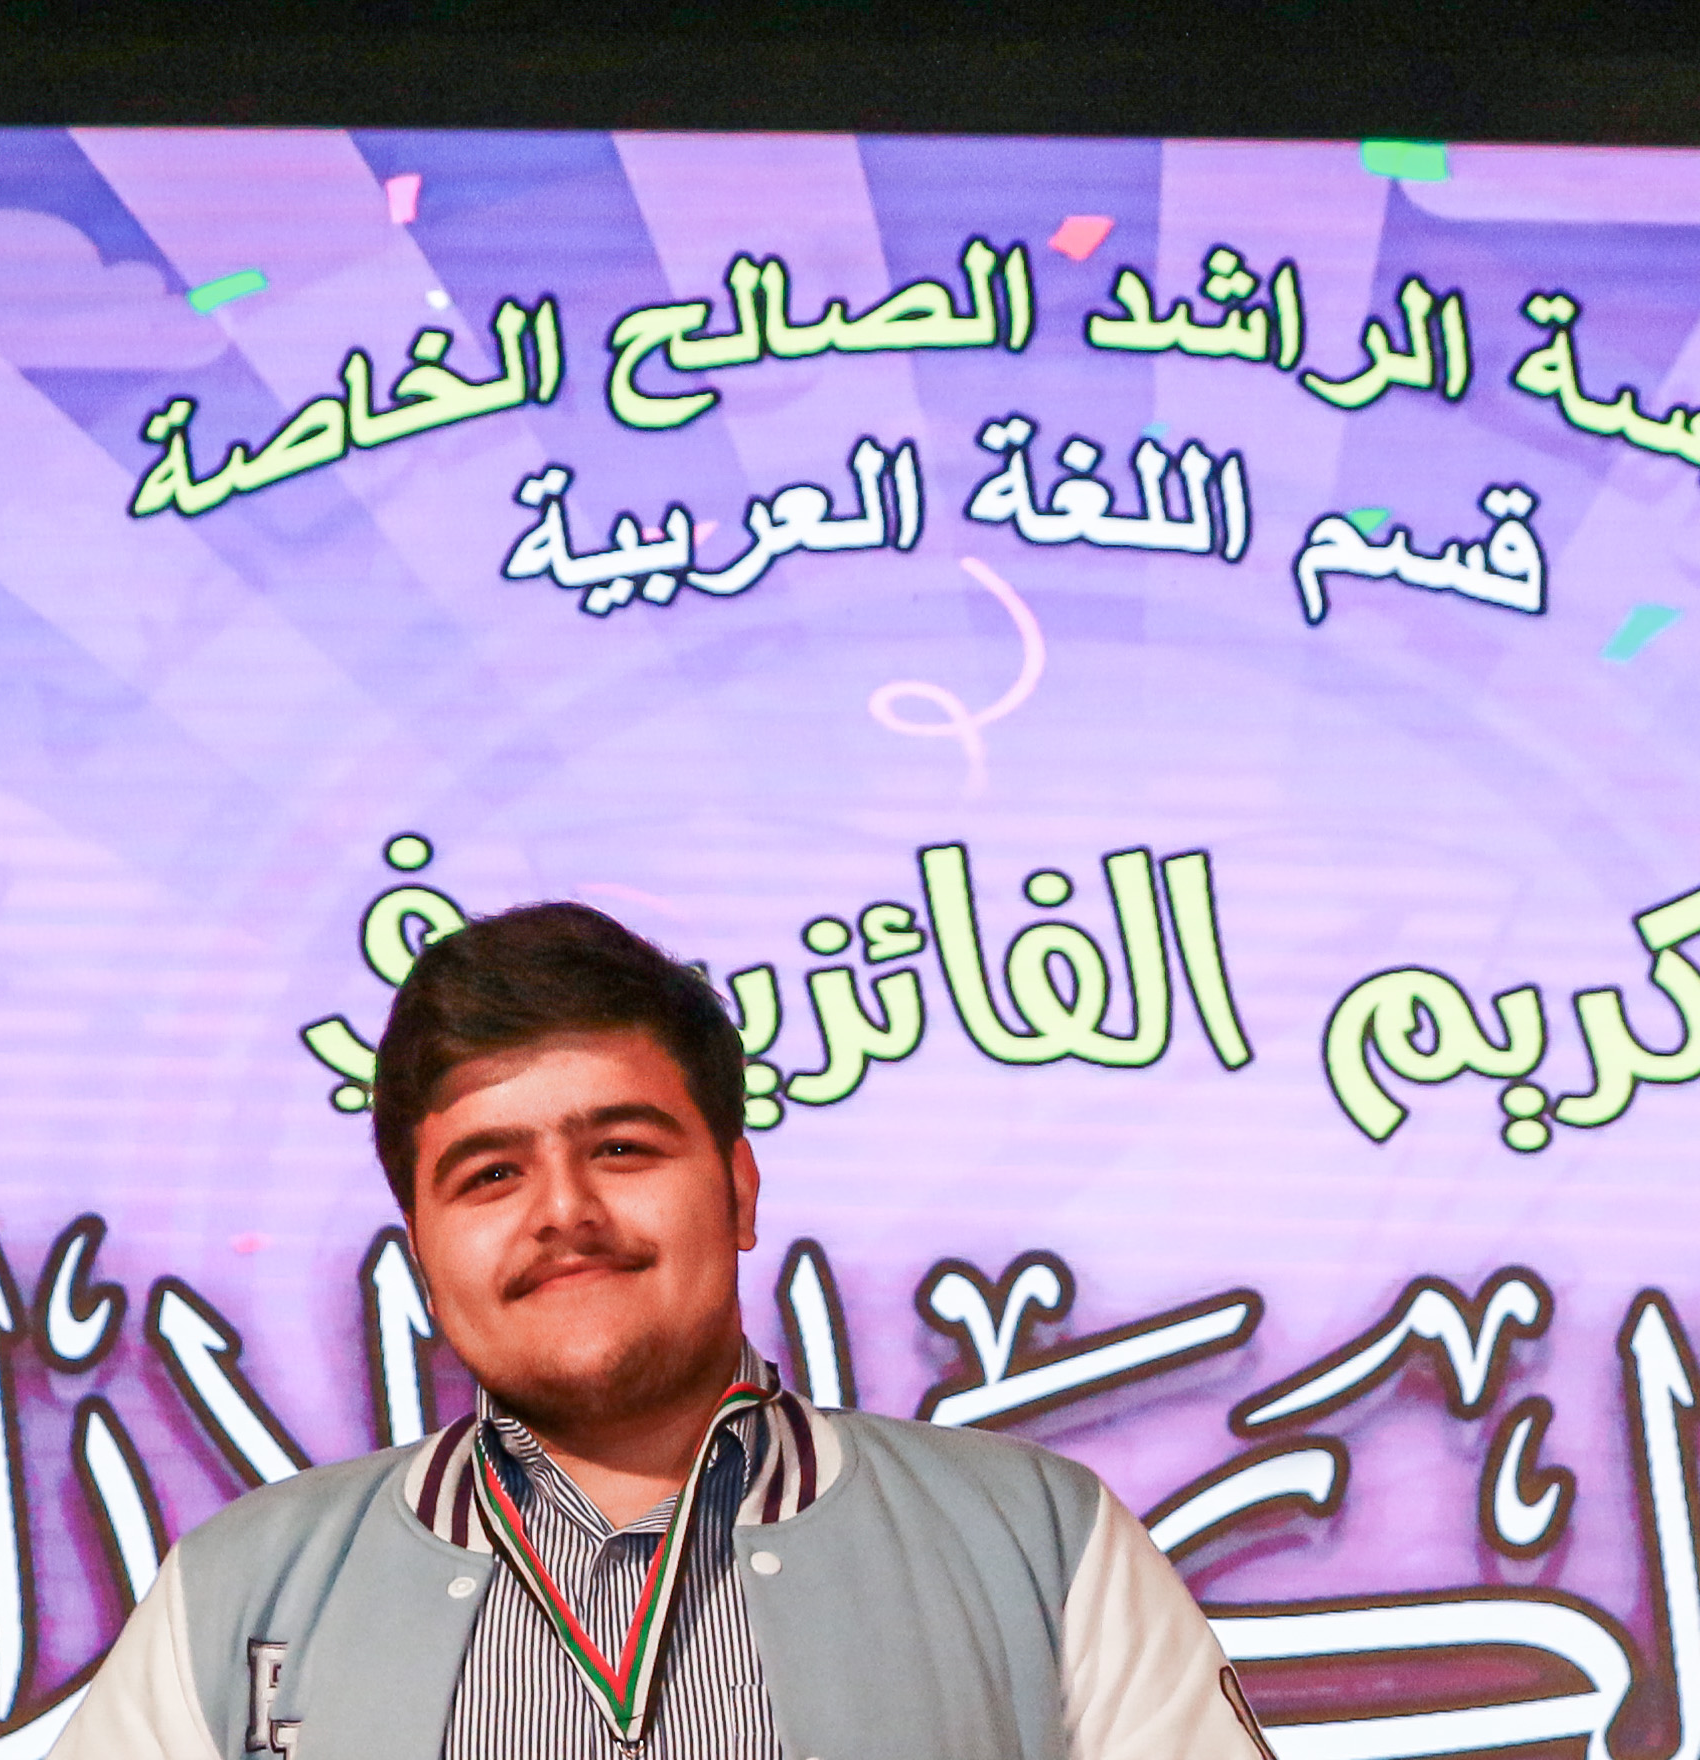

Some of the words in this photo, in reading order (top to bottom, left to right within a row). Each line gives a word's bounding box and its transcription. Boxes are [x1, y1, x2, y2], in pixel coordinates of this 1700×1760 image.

[128, 295, 565, 519] الخاصة
[607, 236, 1035, 430] الصالح
[1086, 244, 1472, 409] الراشد
[503, 436, 926, 616] العربية
[968, 412, 1251, 563] اللغة
[1295, 482, 1548, 626] قسم
[724, 838, 1255, 1135] الفائزي
